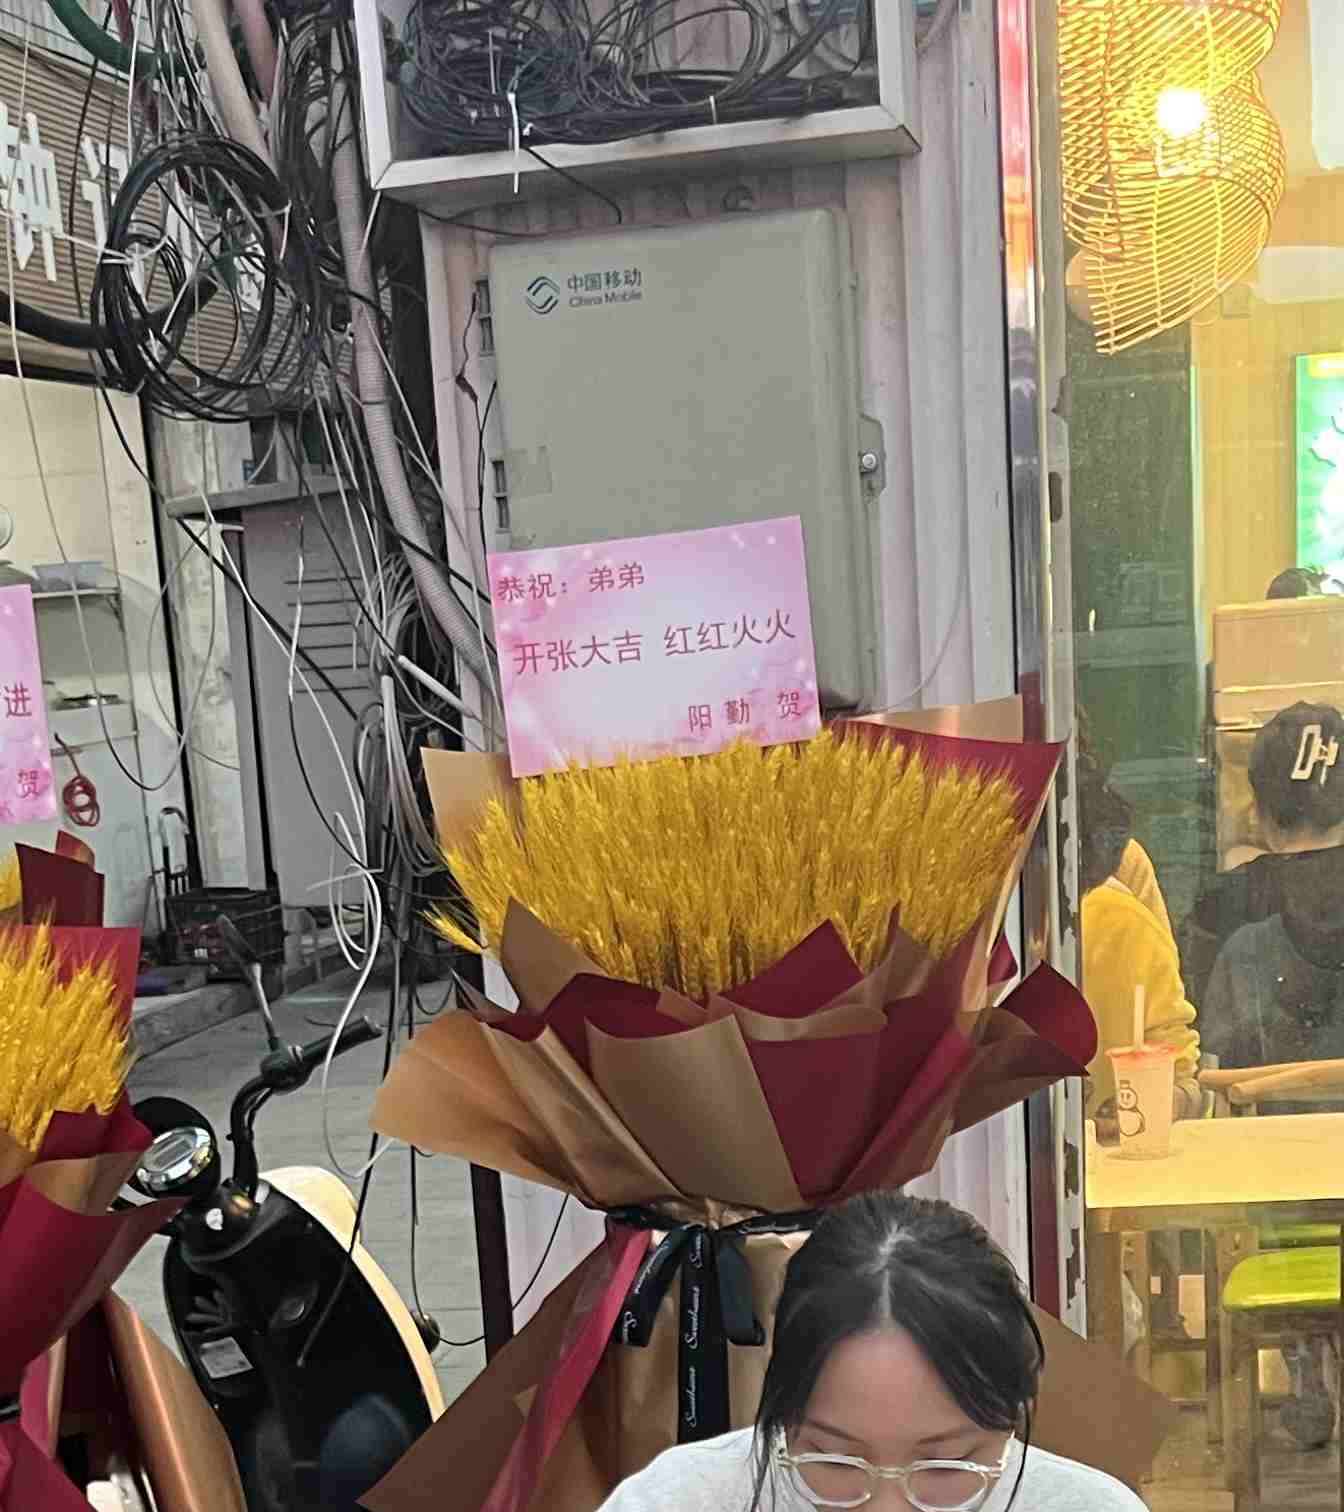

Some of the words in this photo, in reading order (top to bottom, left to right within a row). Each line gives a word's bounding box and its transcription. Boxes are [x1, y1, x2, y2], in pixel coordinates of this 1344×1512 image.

[567, 267, 643, 293] 中国移动
[512, 629, 645, 676] 开张大吉
[663, 608, 797, 657] 红红火火
